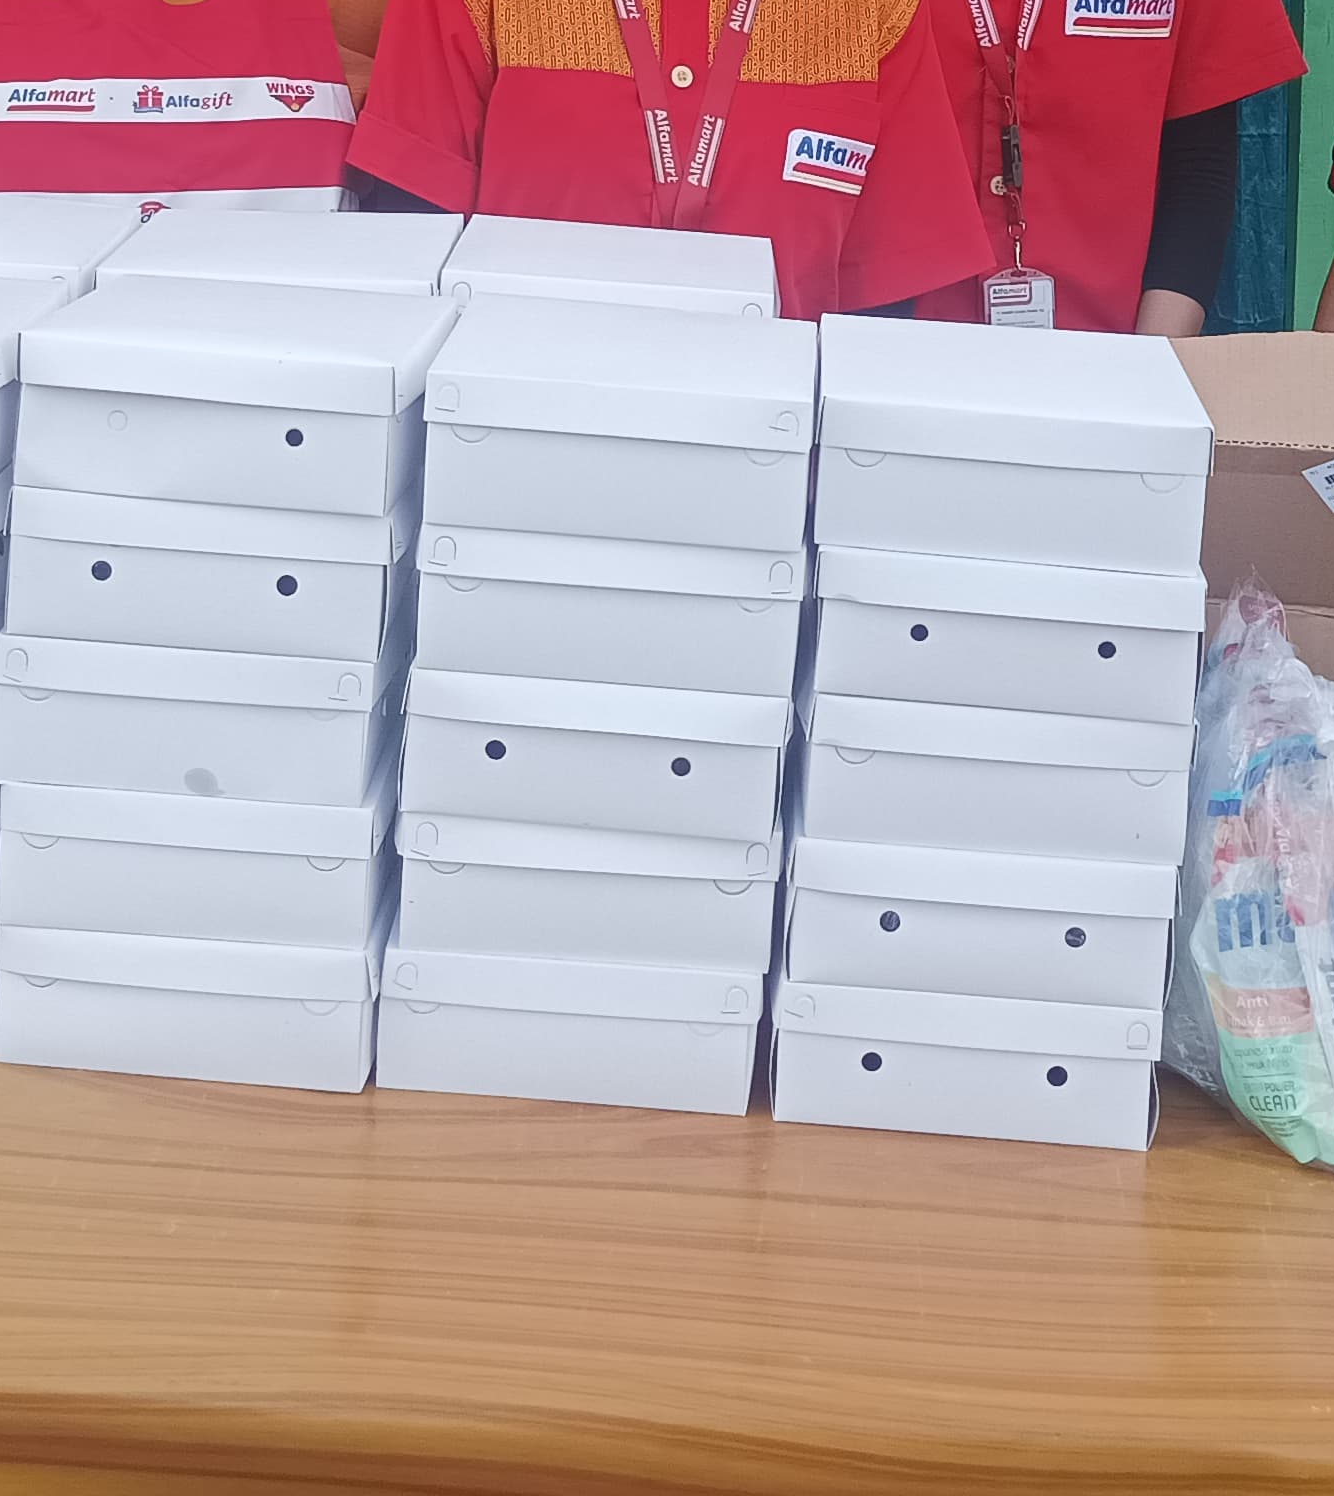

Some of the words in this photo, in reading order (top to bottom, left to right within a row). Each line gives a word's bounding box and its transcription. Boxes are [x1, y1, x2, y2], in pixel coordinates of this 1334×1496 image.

[8, 87, 97, 104] Alfamart
[265, 82, 315, 96] WINGS
[166, 92, 233, 111] Alfagift
[654, 109, 679, 185] Alfamart
[687, 114, 715, 187] Alfamart
[797, 135, 871, 171] Alfam
[1250, 1094, 1298, 1113] CLEAN
